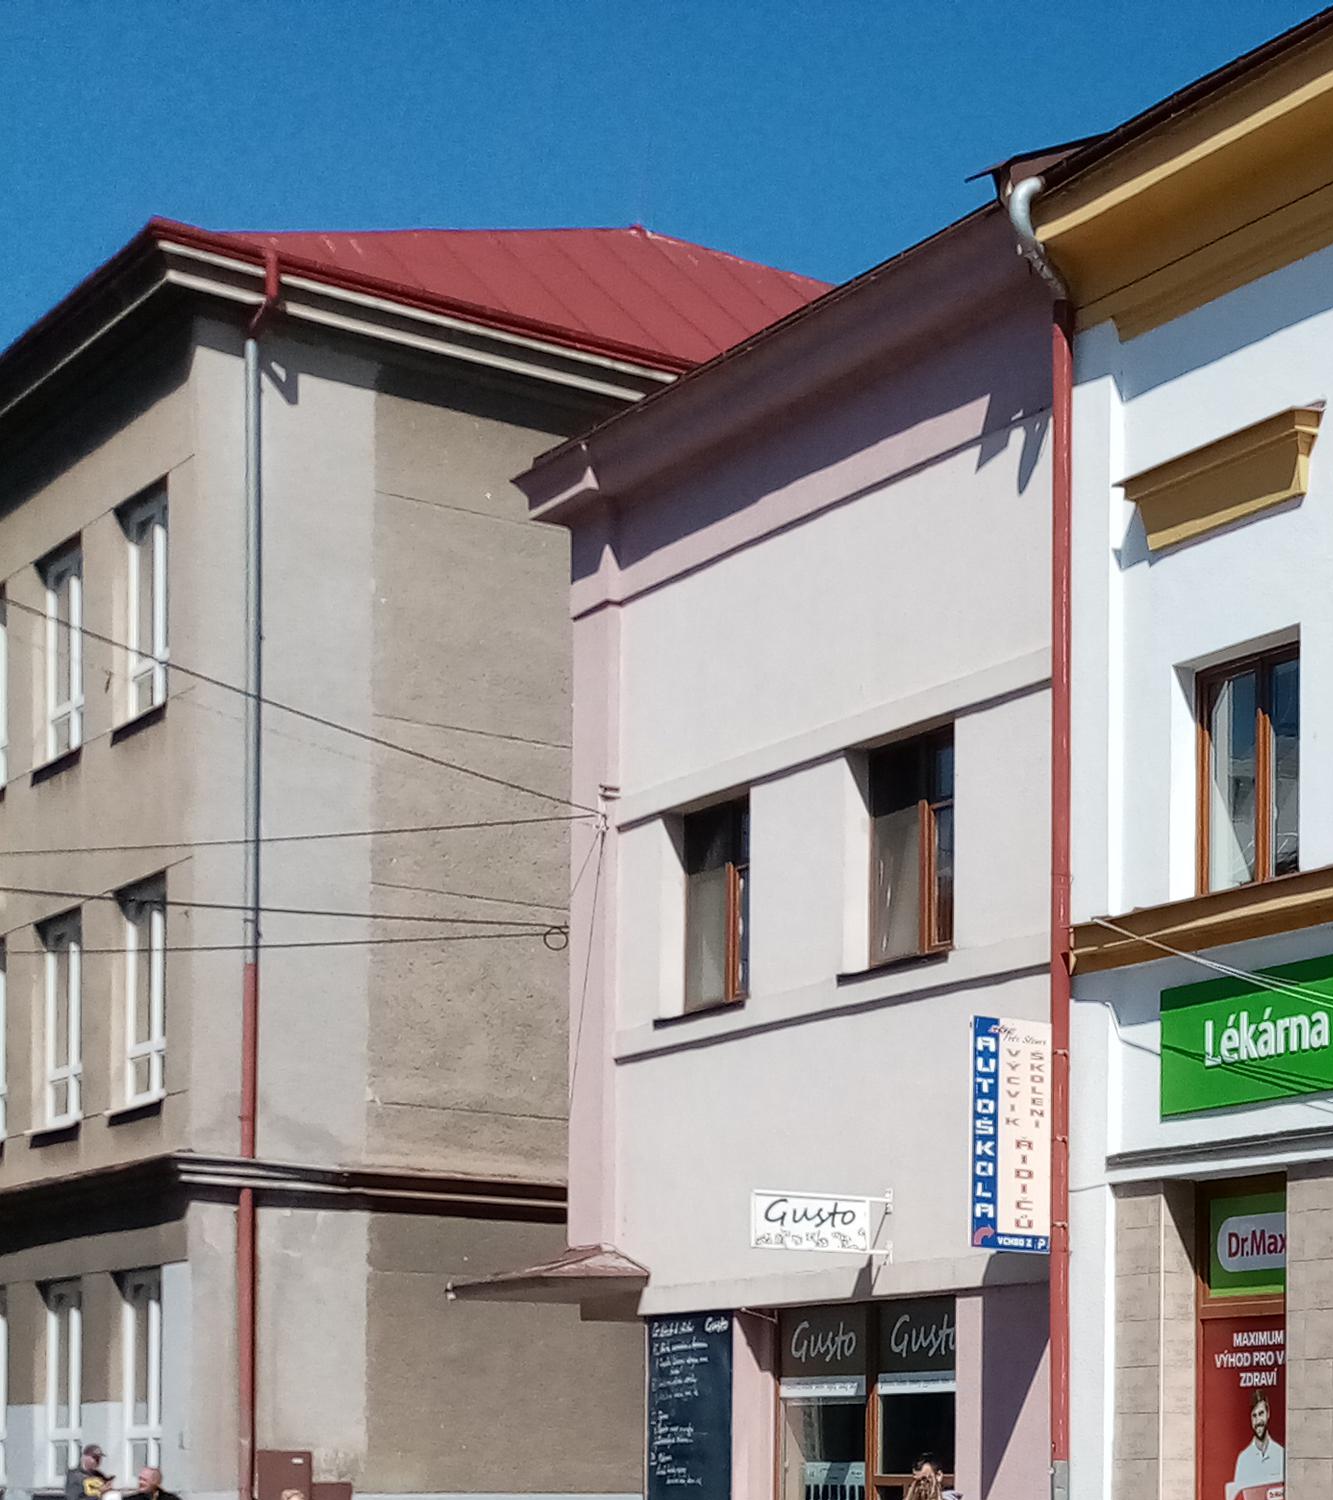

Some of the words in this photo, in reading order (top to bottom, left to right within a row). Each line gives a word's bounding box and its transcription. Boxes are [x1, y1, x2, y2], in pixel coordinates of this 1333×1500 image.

[1204, 1006, 1330, 1068] Lékárna
[974, 1035, 996, 1219] AUTOŠKOLA
[764, 1198, 856, 1228] Gusto
[1228, 1229, 1287, 1258] Dr.Max
[790, 1321, 857, 1363] Gusto
[1233, 1330, 1285, 1347] MAXIMUM
[1214, 1350, 1251, 1368] VÝHOD
[1252, 1351, 1275, 1366] PRO
[1239, 1367, 1278, 1387] ZDRAVÍ
